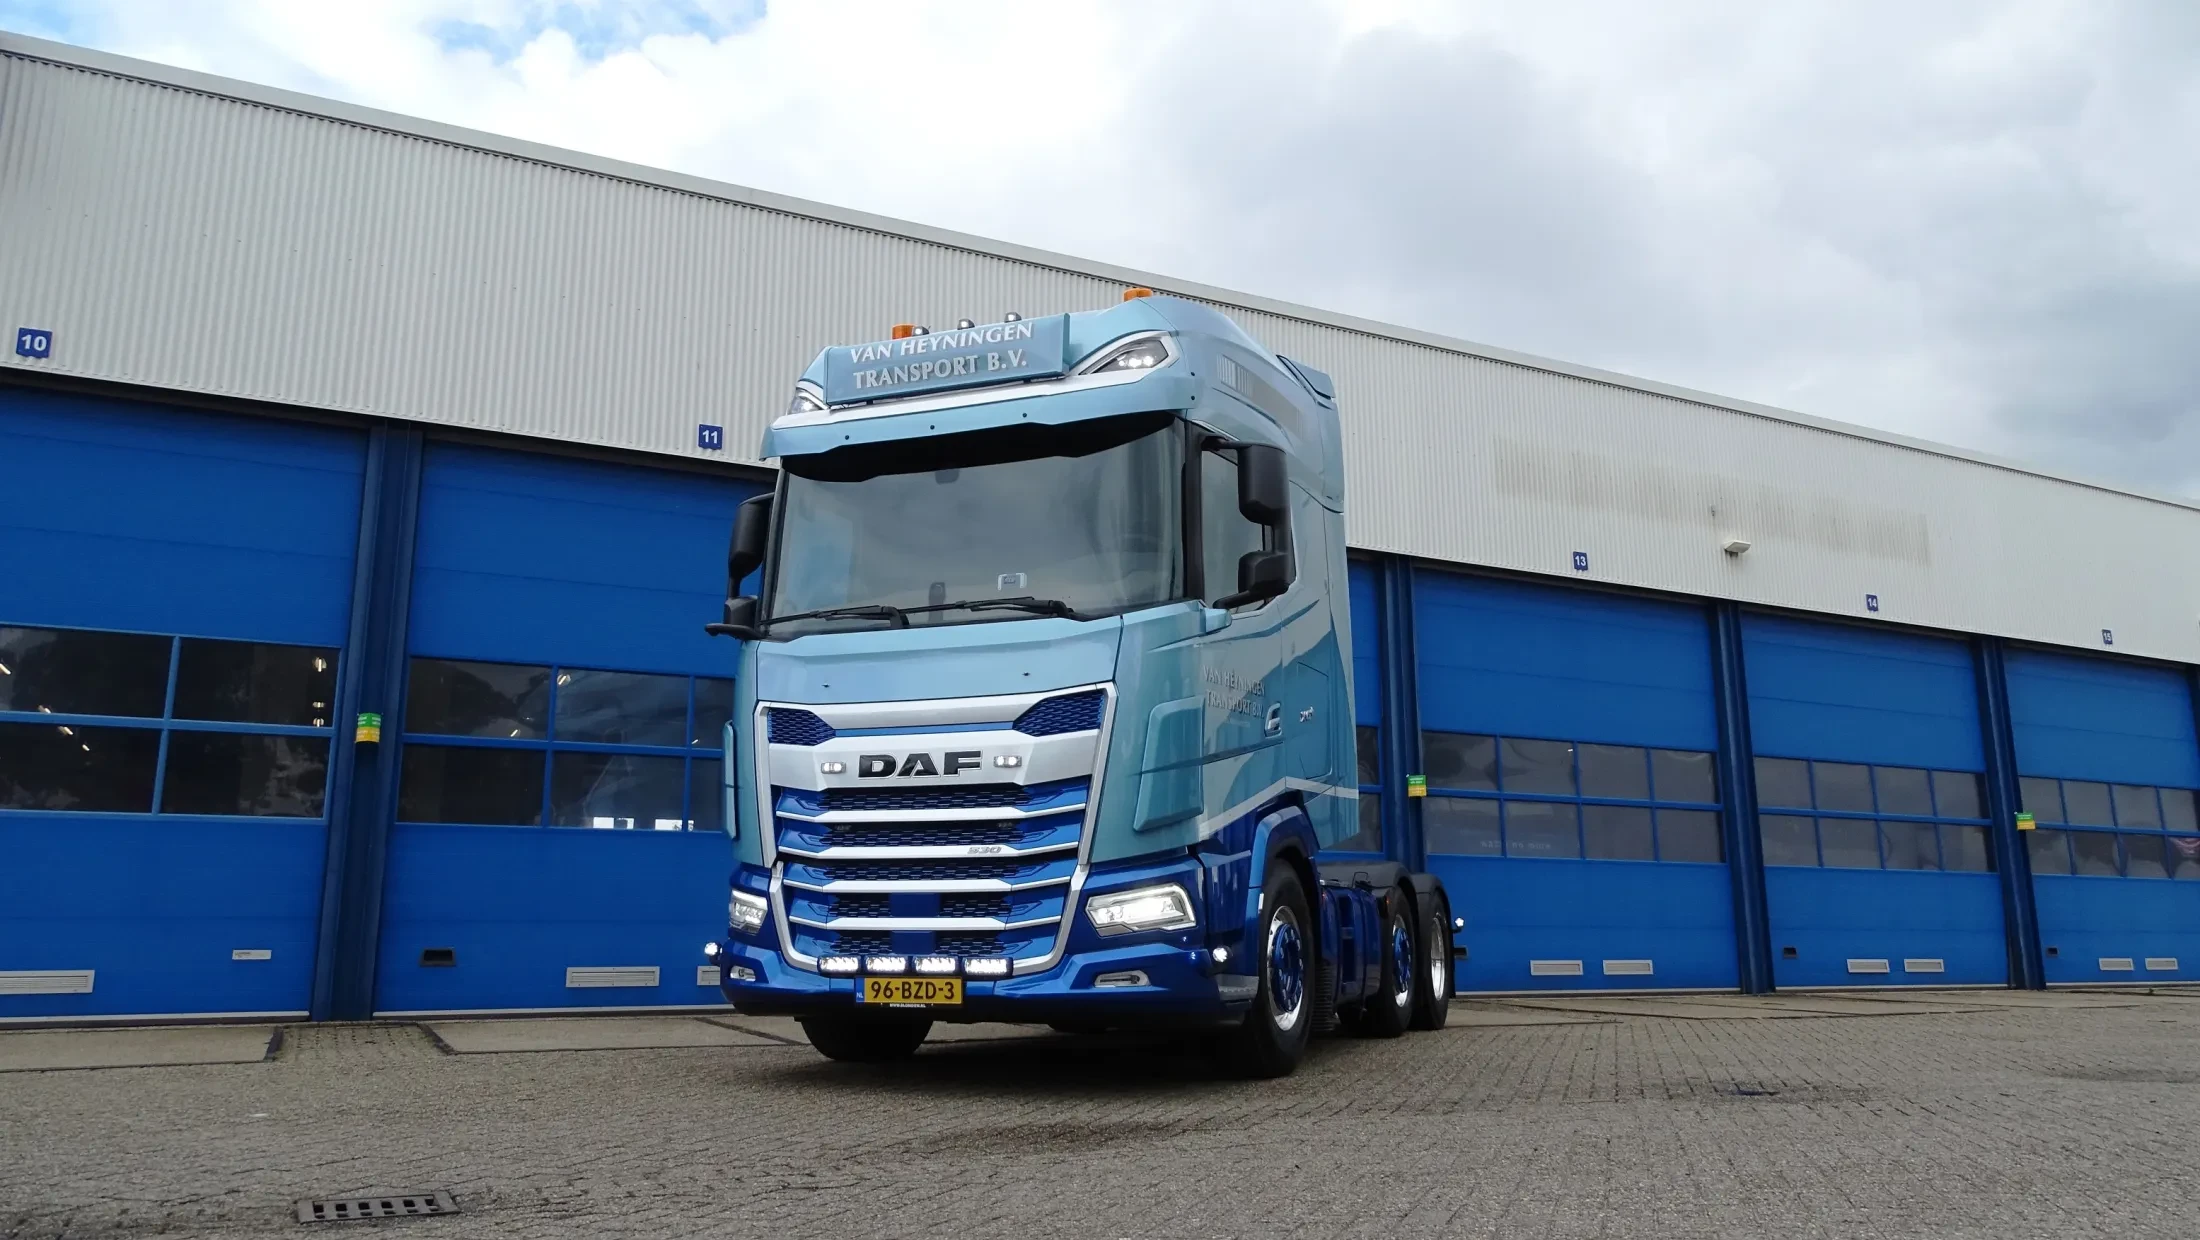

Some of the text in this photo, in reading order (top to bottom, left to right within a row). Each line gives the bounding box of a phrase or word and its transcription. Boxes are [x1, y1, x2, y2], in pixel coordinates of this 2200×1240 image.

[21, 334, 47, 351] 10
[850, 322, 1034, 364] VAN HEYNINGEN
[853, 347, 1028, 390] TRANSPORT B.V.
[702, 429, 718, 444] 11
[1574, 555, 1587, 567] 13
[1867, 597, 1878, 608] 14
[1203, 664, 1223, 686] VAN
[1206, 689, 1251, 716] TRANSPORT
[857, 750, 984, 780] DAF
[871, 980, 955, 1000] 96-BZD-3
